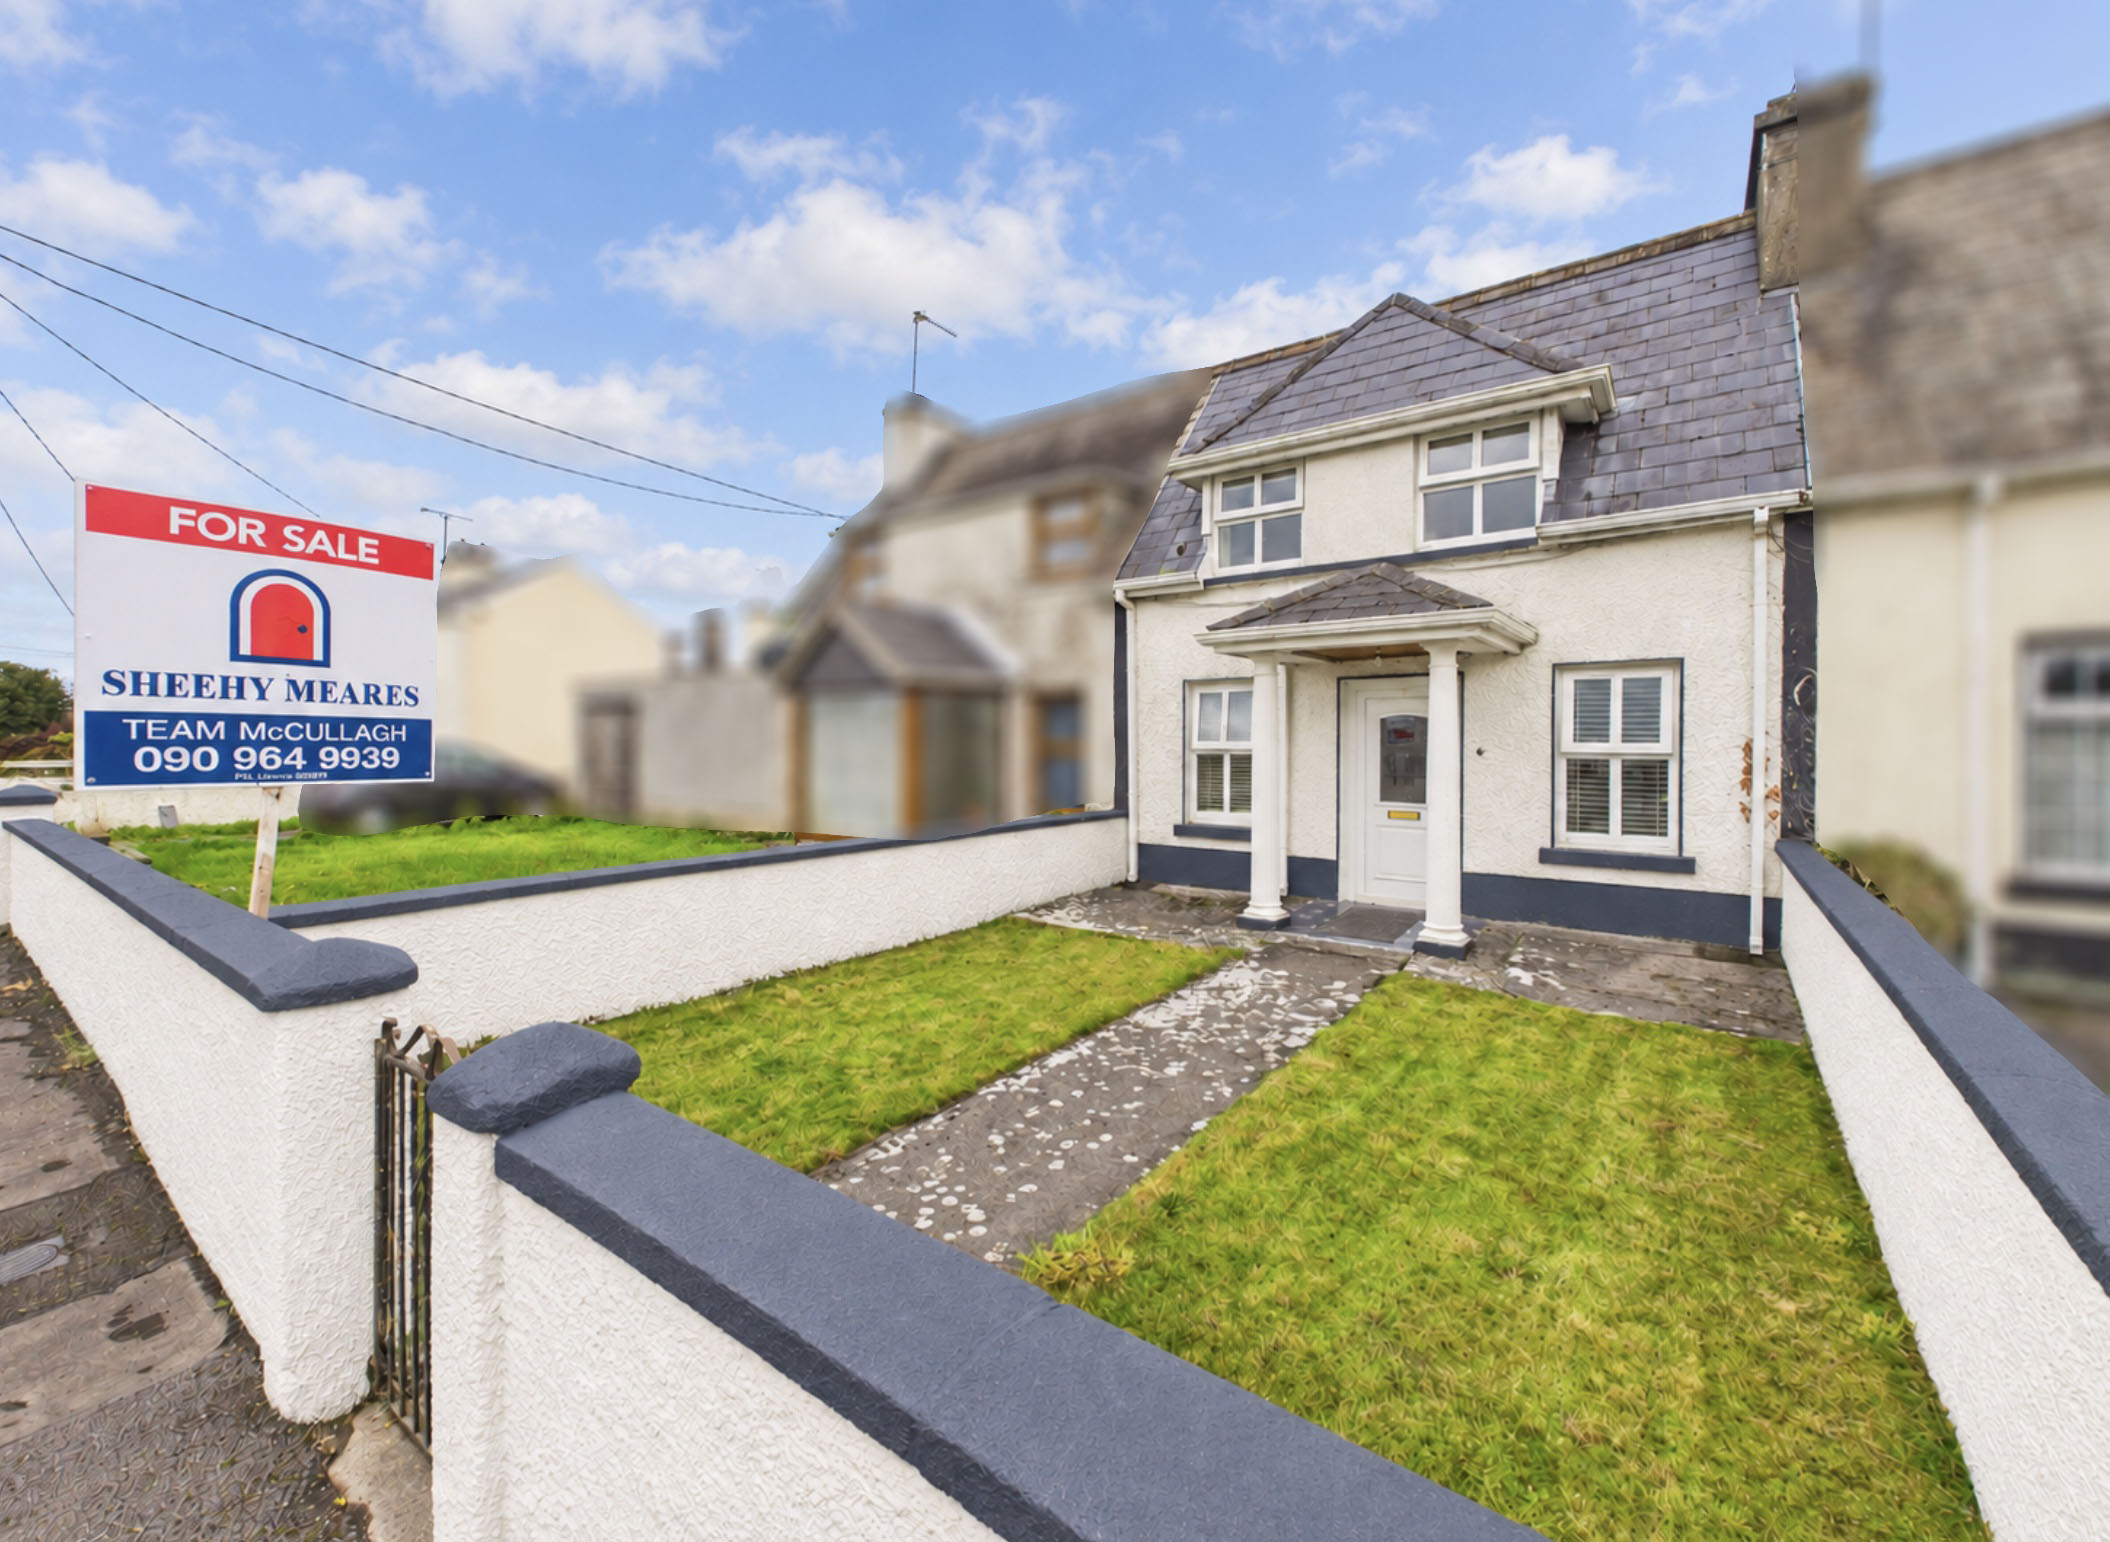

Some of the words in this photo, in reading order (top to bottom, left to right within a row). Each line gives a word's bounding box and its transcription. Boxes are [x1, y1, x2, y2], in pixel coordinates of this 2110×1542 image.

[170, 506, 266, 547] FOR
[283, 524, 380, 564] SALE
[102, 669, 274, 701] SHEEHY
[285, 678, 420, 707] MEARES
[122, 718, 225, 741] TEAM
[240, 722, 407, 742] McCULLAGH
[134, 745, 220, 773] 090
[233, 745, 307, 770] 964
[319, 746, 400, 770] 9939
